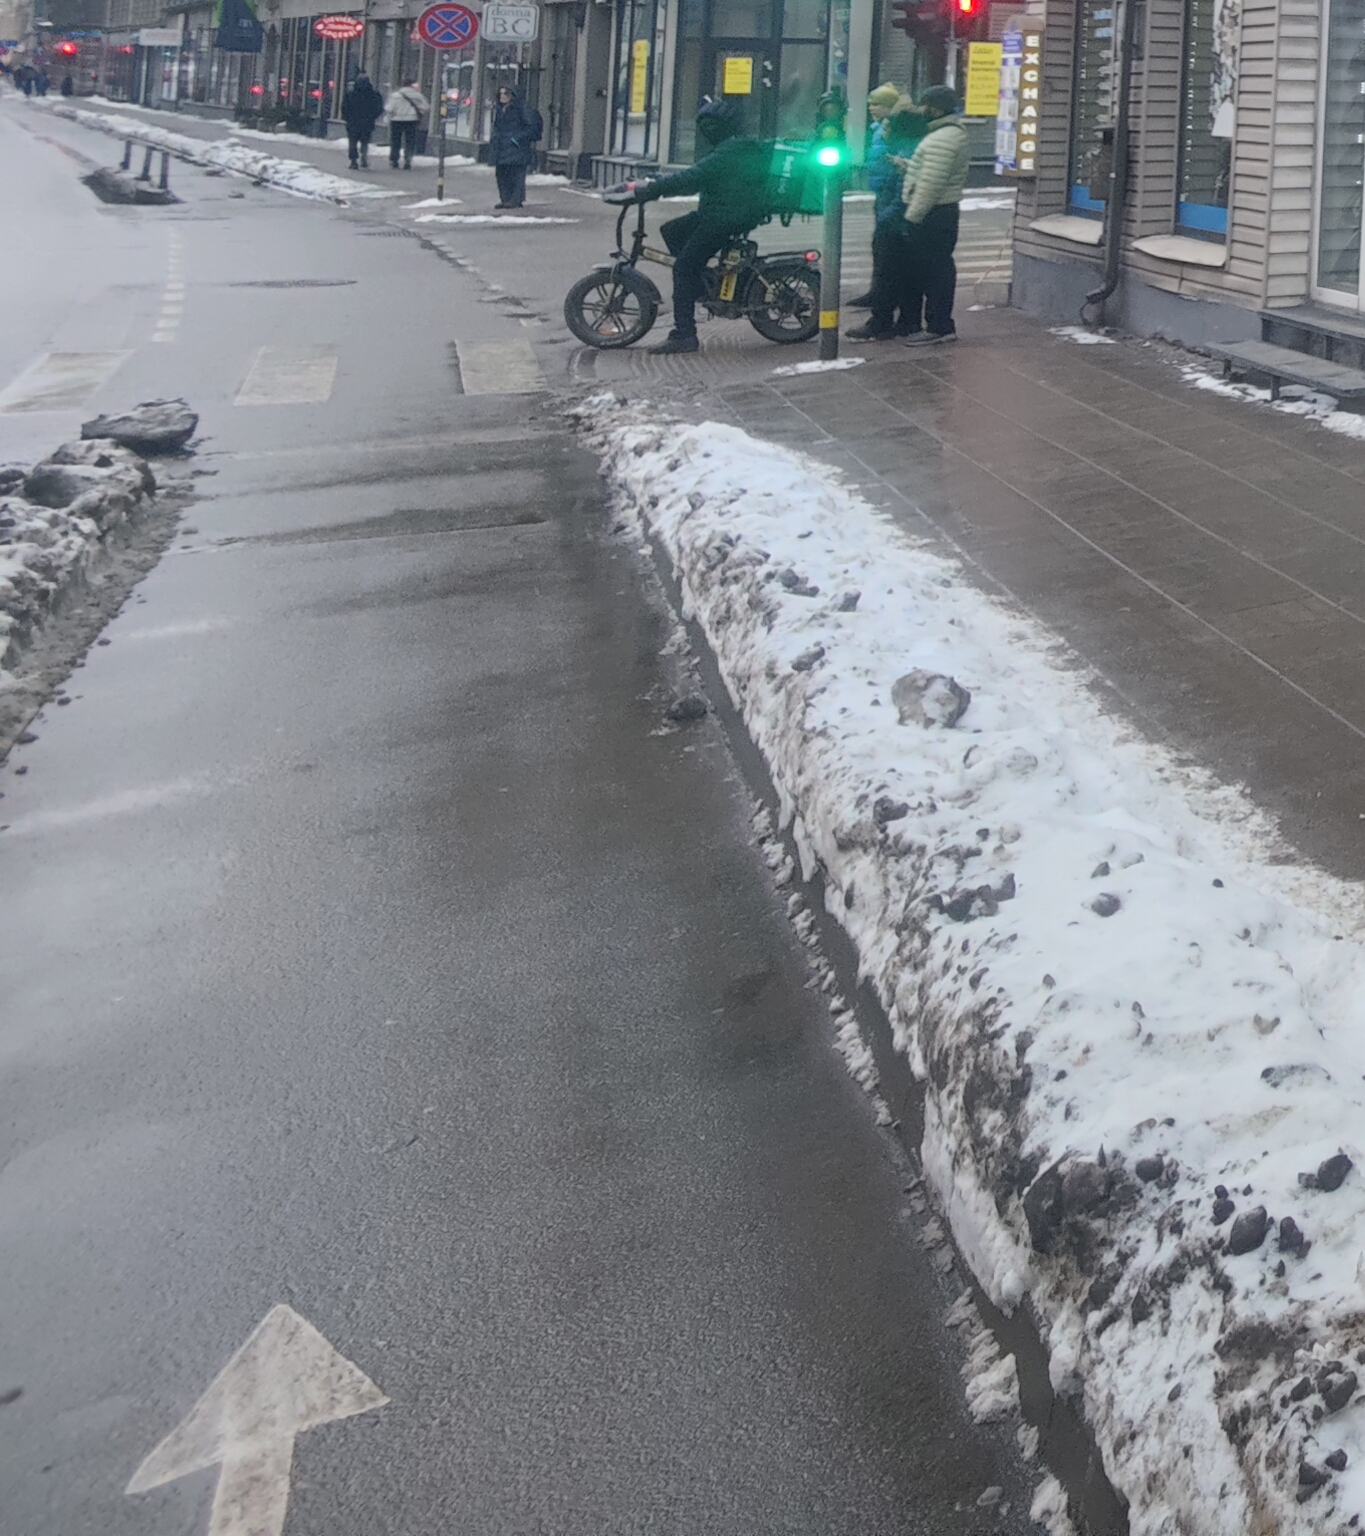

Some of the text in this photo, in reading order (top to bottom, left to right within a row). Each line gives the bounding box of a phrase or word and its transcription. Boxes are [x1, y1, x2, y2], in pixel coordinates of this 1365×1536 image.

[491, 2, 531, 17] donna
[491, 18, 531, 35] BC
[1019, 35, 1040, 170] EXCHANGE
